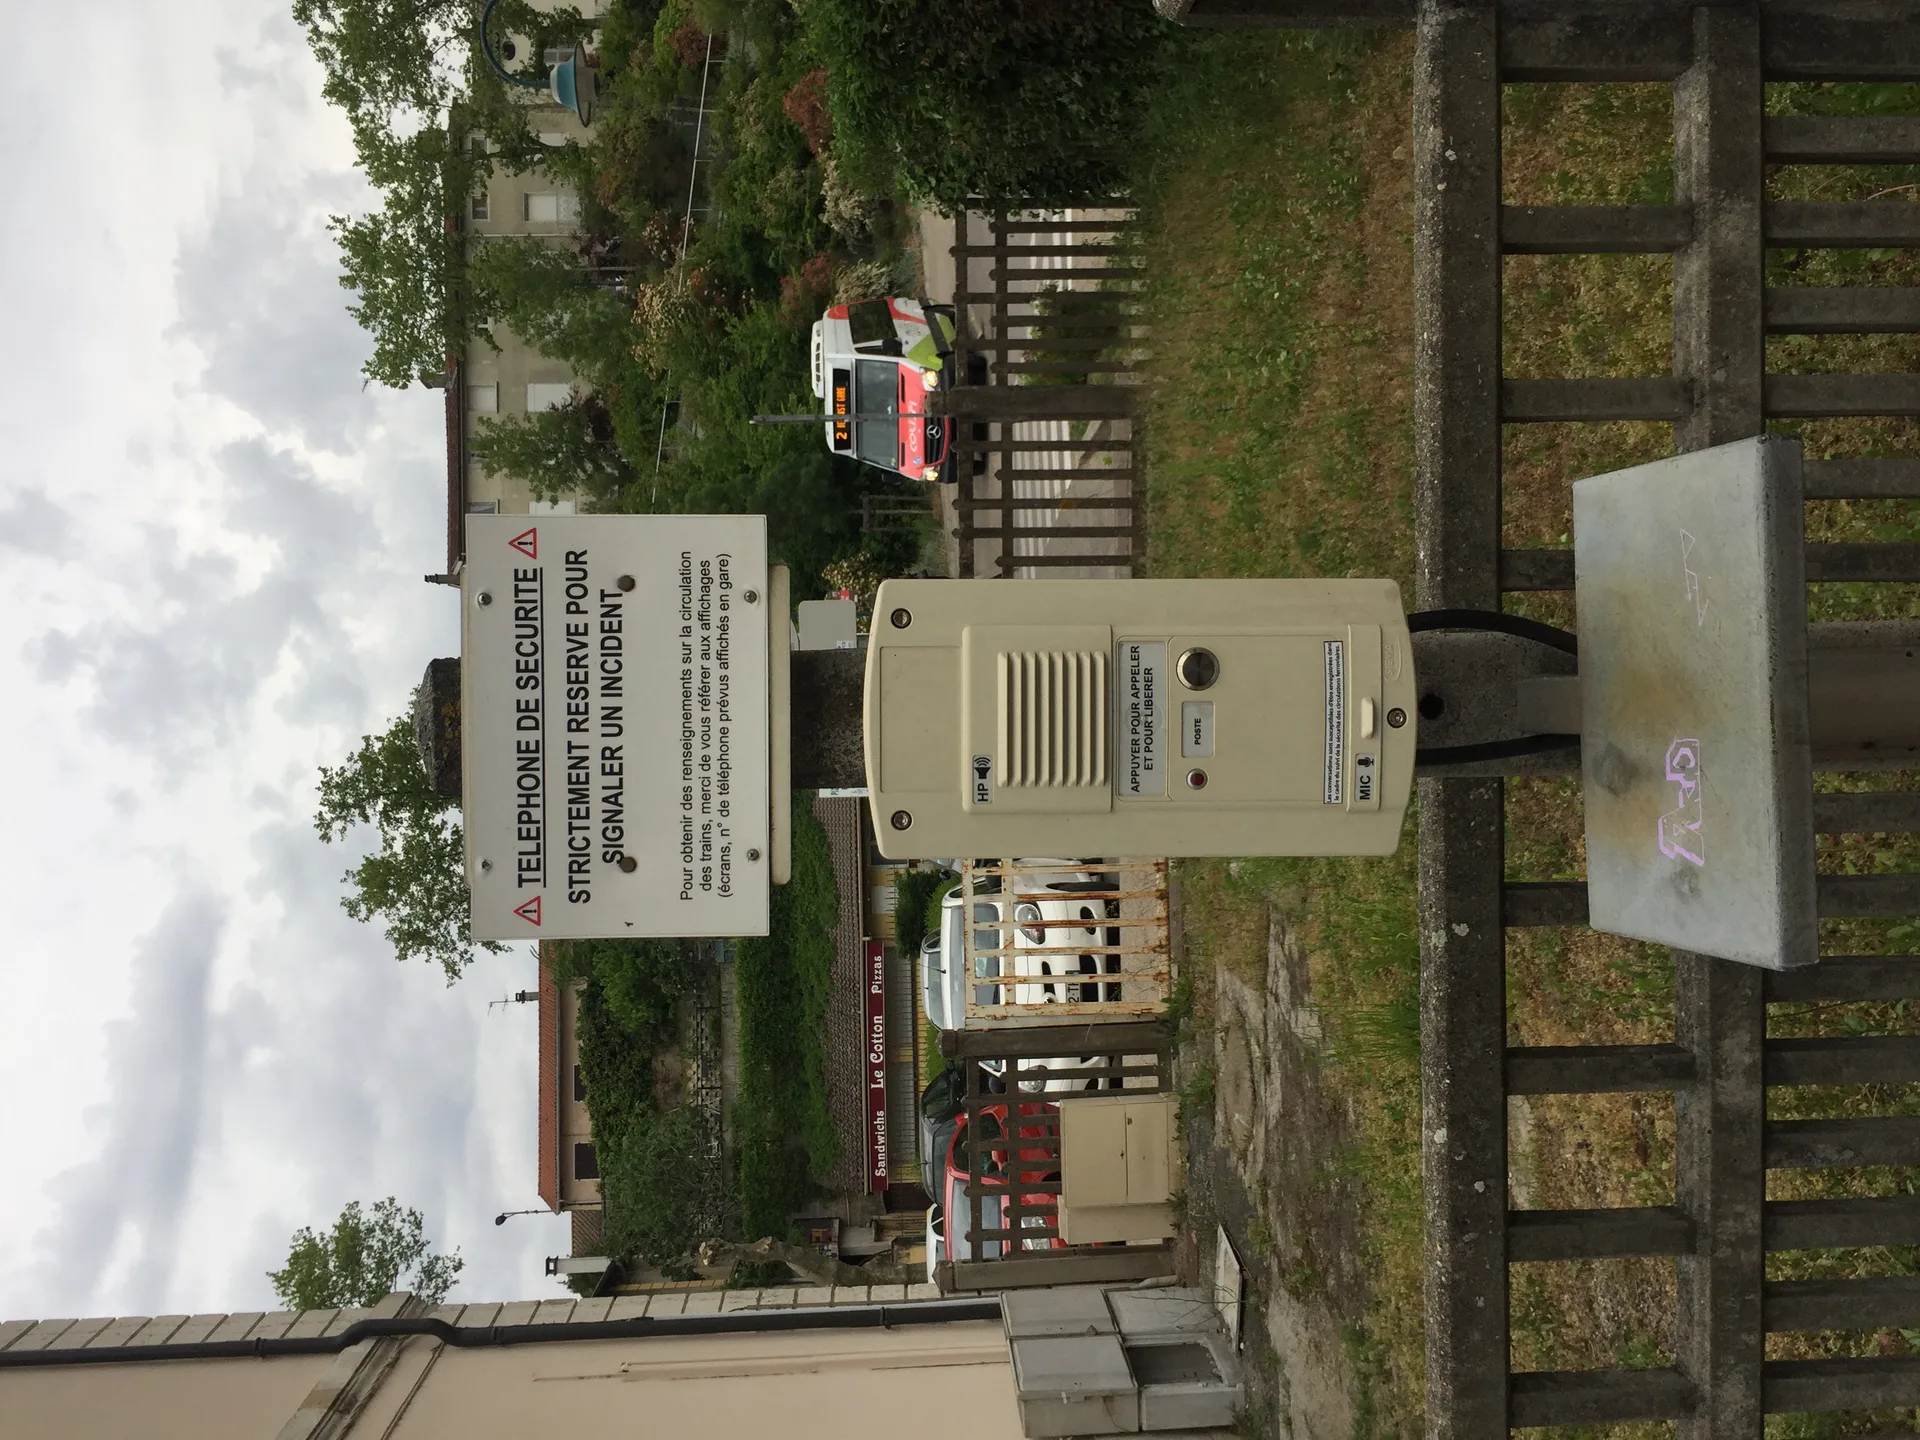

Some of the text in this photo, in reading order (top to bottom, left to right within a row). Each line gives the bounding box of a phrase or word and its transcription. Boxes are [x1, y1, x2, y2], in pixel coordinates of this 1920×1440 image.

[836, 432, 847, 440] 2
[514, 568, 541, 887] TELEPHONE DE SECURITE
[565, 550, 591, 904] STRICTEMENT RESERVE POUR
[599, 589, 624, 864] SIGNALER UN INCIDENT
[678, 551, 696, 900] Pour obtenir des renseignements sur la circulation
[697, 560, 714, 892] des trains, merci de vous référer aux affichages
[715, 553, 733, 898] (écrans, n° de téléphone prévus affichés en gare)
[977, 782, 989, 802] HP
[1129, 645, 1141, 792] APPUYER POUR APPELER
[1143, 667, 1154, 771] ET POUR LIBERER
[1193, 718, 1202, 745] POSTE
[1335, 749, 1340, 757] de
[1335, 771, 1340, 779] du
[1359, 775, 1371, 801] MIC
[870, 956, 886, 1177] Sandwichs Le Cotton Pizzas
